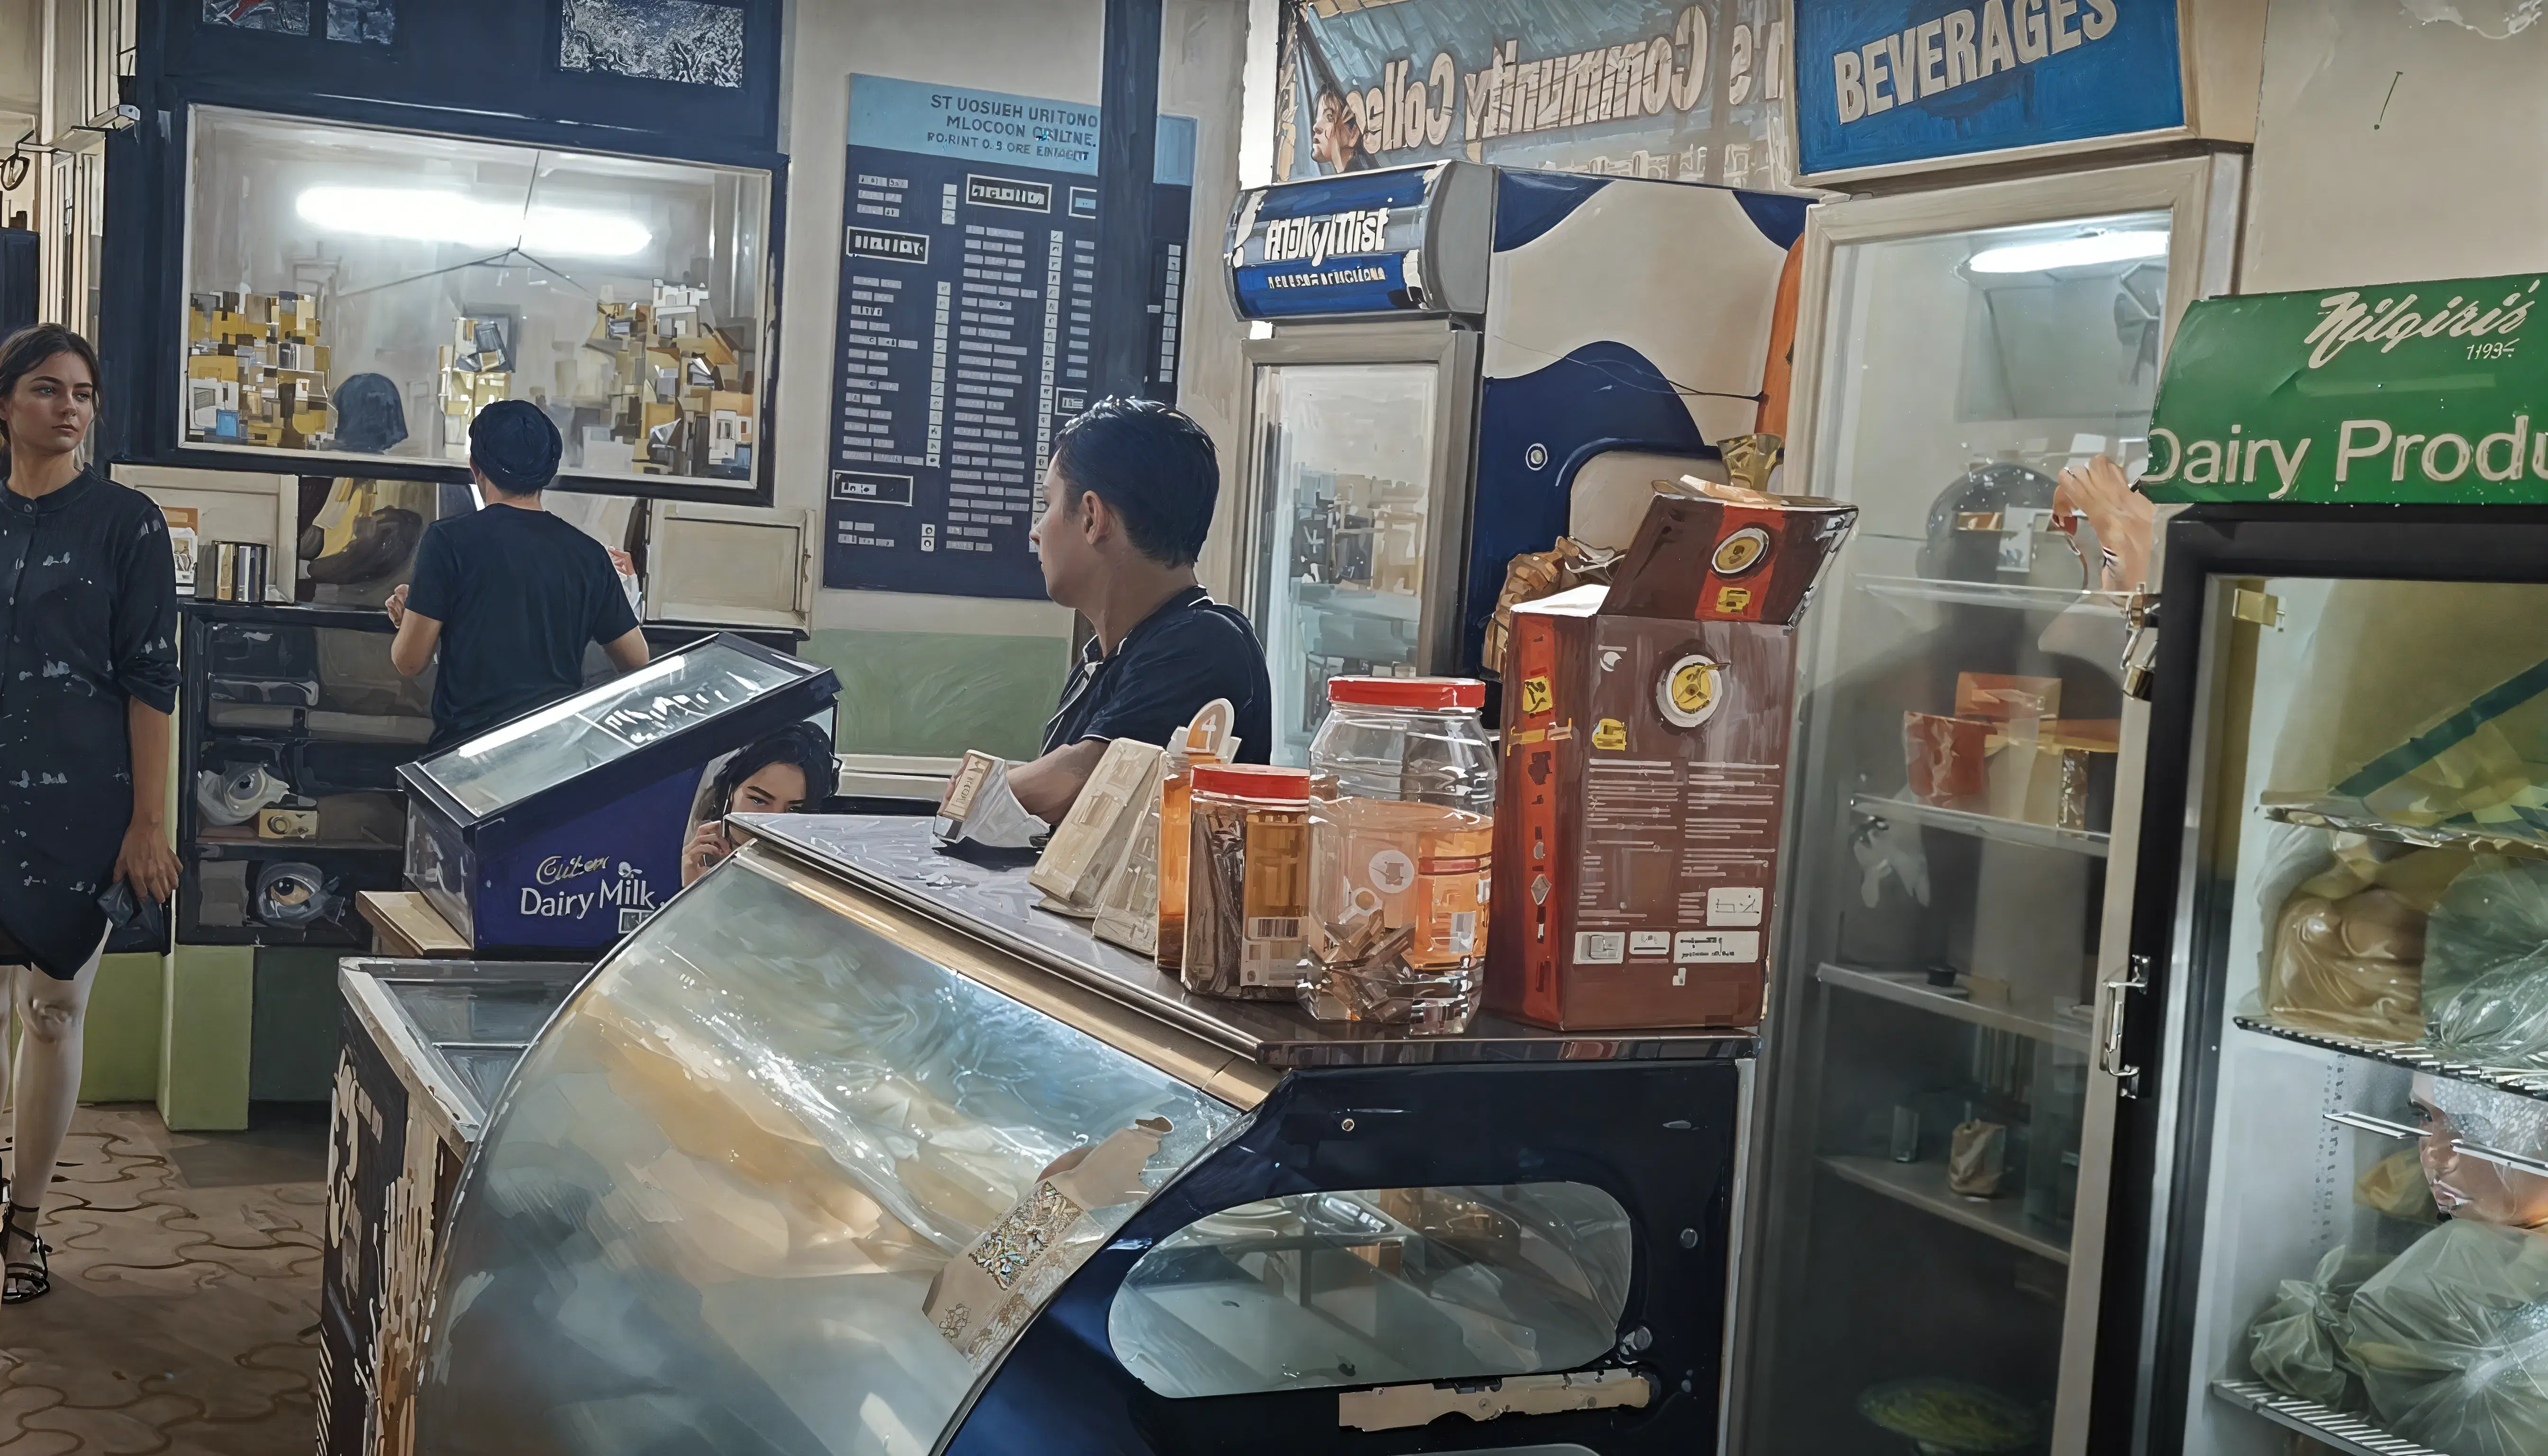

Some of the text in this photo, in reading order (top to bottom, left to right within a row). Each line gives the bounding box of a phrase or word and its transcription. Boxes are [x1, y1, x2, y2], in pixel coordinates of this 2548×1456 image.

[1833, 0, 2117, 125] BEVERAGES
[930, 94, 953, 109] ST
[946, 115, 1025, 137] MLOCOON
[2303, 279, 2540, 369] Nilgiri's
[2139, 424, 2311, 499] Dairy
[521, 879, 656, 919] Dairy Milk
